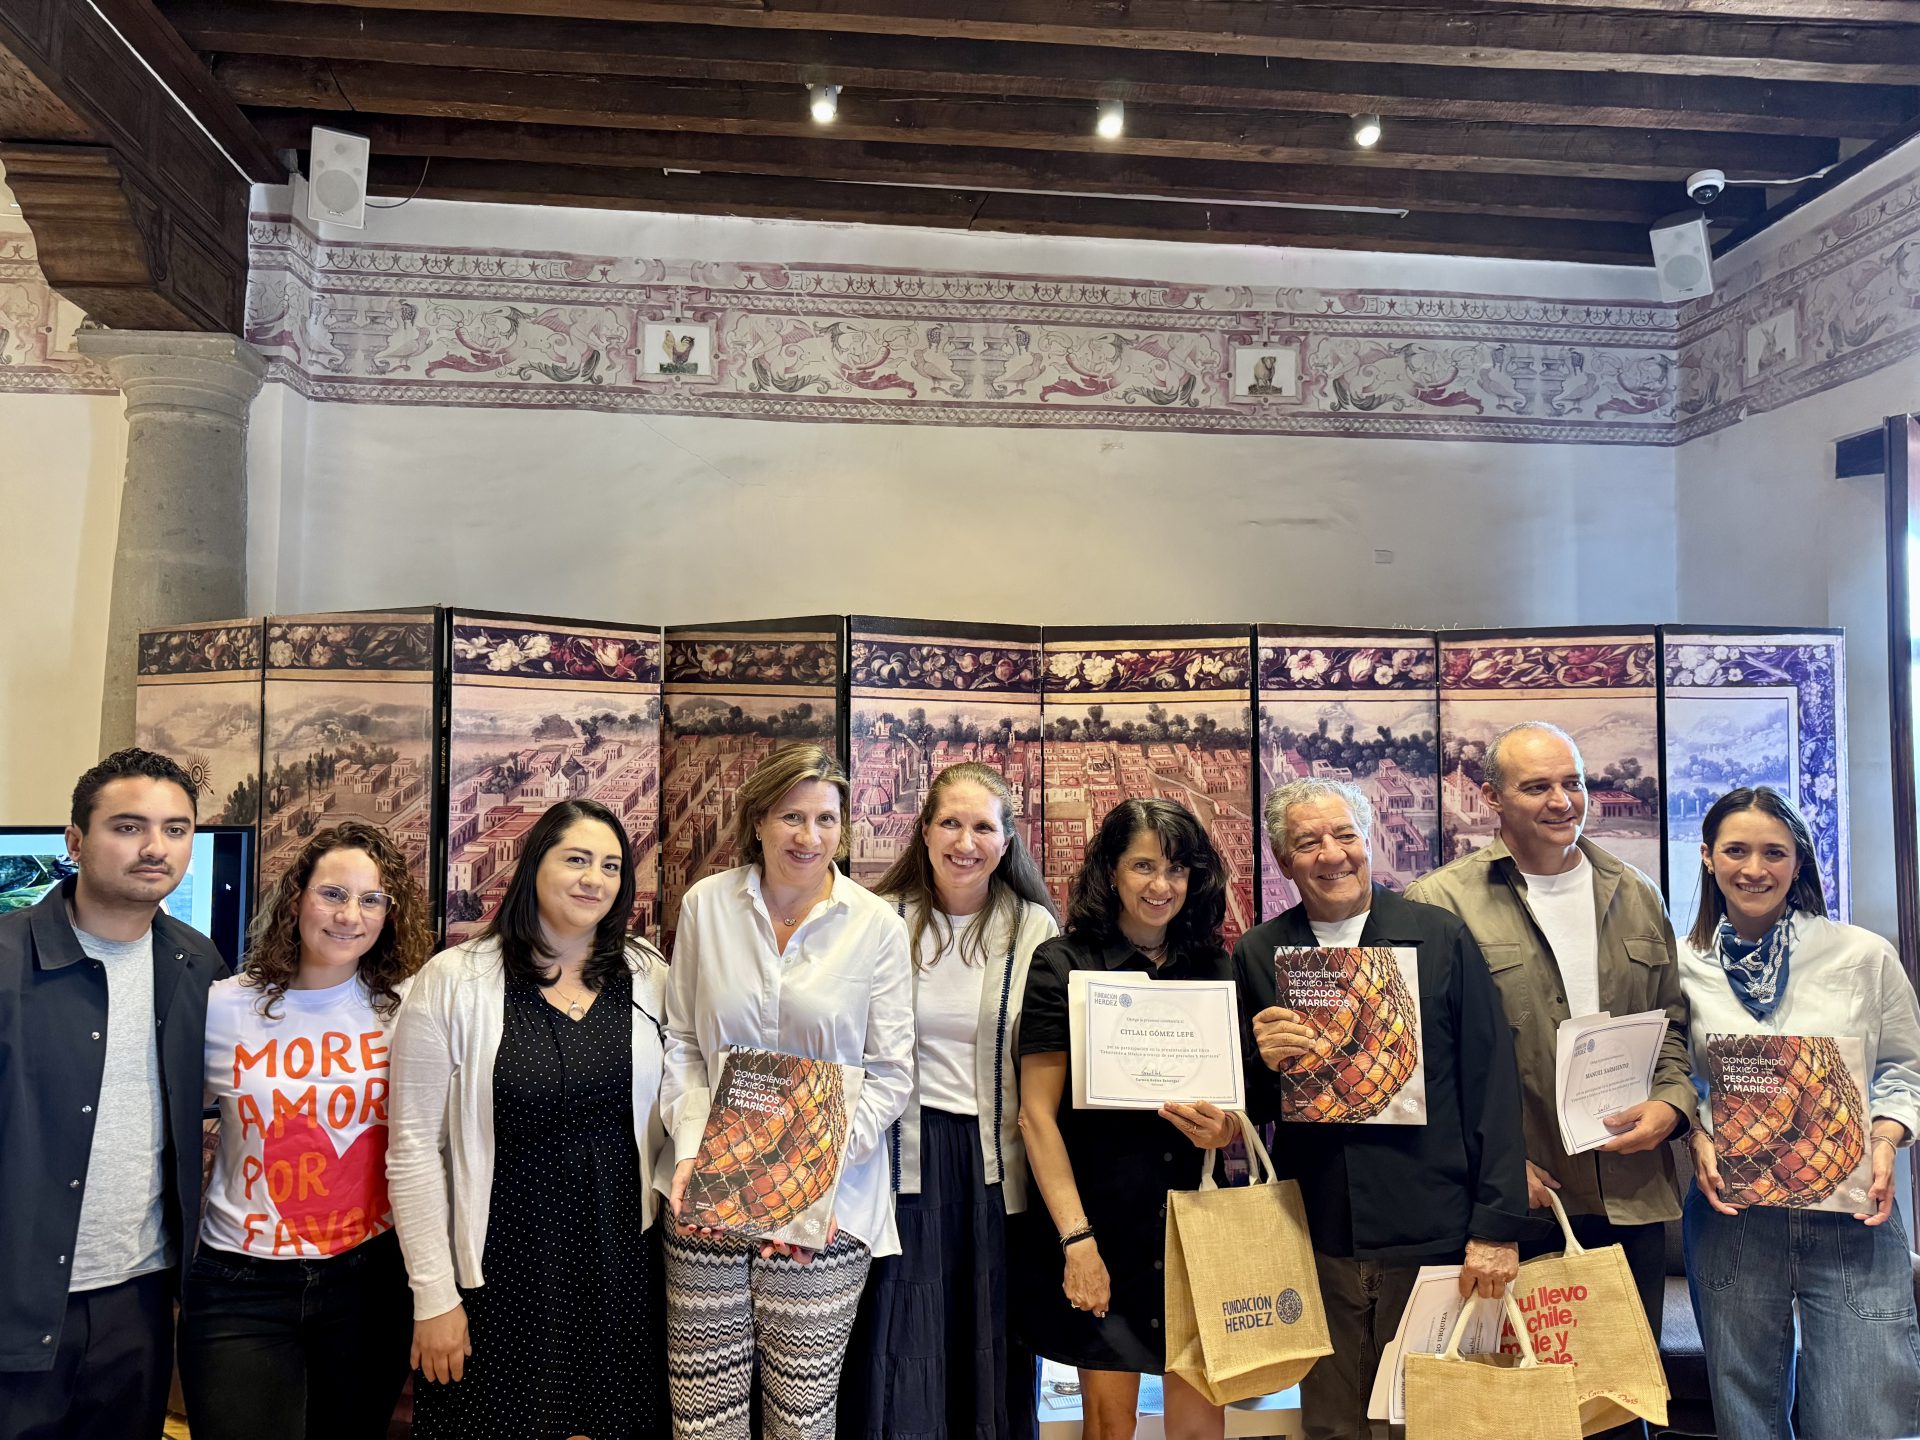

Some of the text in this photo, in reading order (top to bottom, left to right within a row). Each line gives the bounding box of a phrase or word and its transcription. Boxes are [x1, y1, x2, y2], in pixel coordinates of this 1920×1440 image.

[1288, 970, 1348, 979] CONOCIENDO
[1288, 979, 1323, 987] MÉXICO
[1094, 998, 1118, 1007] HERDEZ
[1289, 989, 1342, 998] PESCADOS
[1289, 998, 1351, 1008] Y MARISCOS
[1120, 1028, 1148, 1037] CITLALI
[233, 1031, 390, 1089] MORE
[1722, 1057, 1785, 1065] CONOCIENDO
[1722, 1065, 1758, 1073] MÉXICO
[731, 1078, 766, 1091] MÉXICO
[734, 1069, 793, 1087] CONOCIENDO
[1723, 1075, 1779, 1084] PESCADOS
[728, 1087, 781, 1105] PESCADOS
[1723, 1083, 1789, 1095] Y MARISCOS
[237, 1077, 389, 1140] AMOR
[727, 1096, 786, 1116] Y MARISCOS
[242, 1152, 330, 1204] POR
[242, 1197, 392, 1256] FAVOR
[1222, 1293, 1272, 1316] FUNDACIÓN
[1538, 1285, 1588, 1308] llevo
[1225, 1312, 1273, 1333] HERDEZ
[1437, 1311, 1448, 1342] URQUIZA
[1526, 1305, 1578, 1334] chile,
[1499, 1333, 1551, 1354] mle
[1555, 1330, 1569, 1354] y
